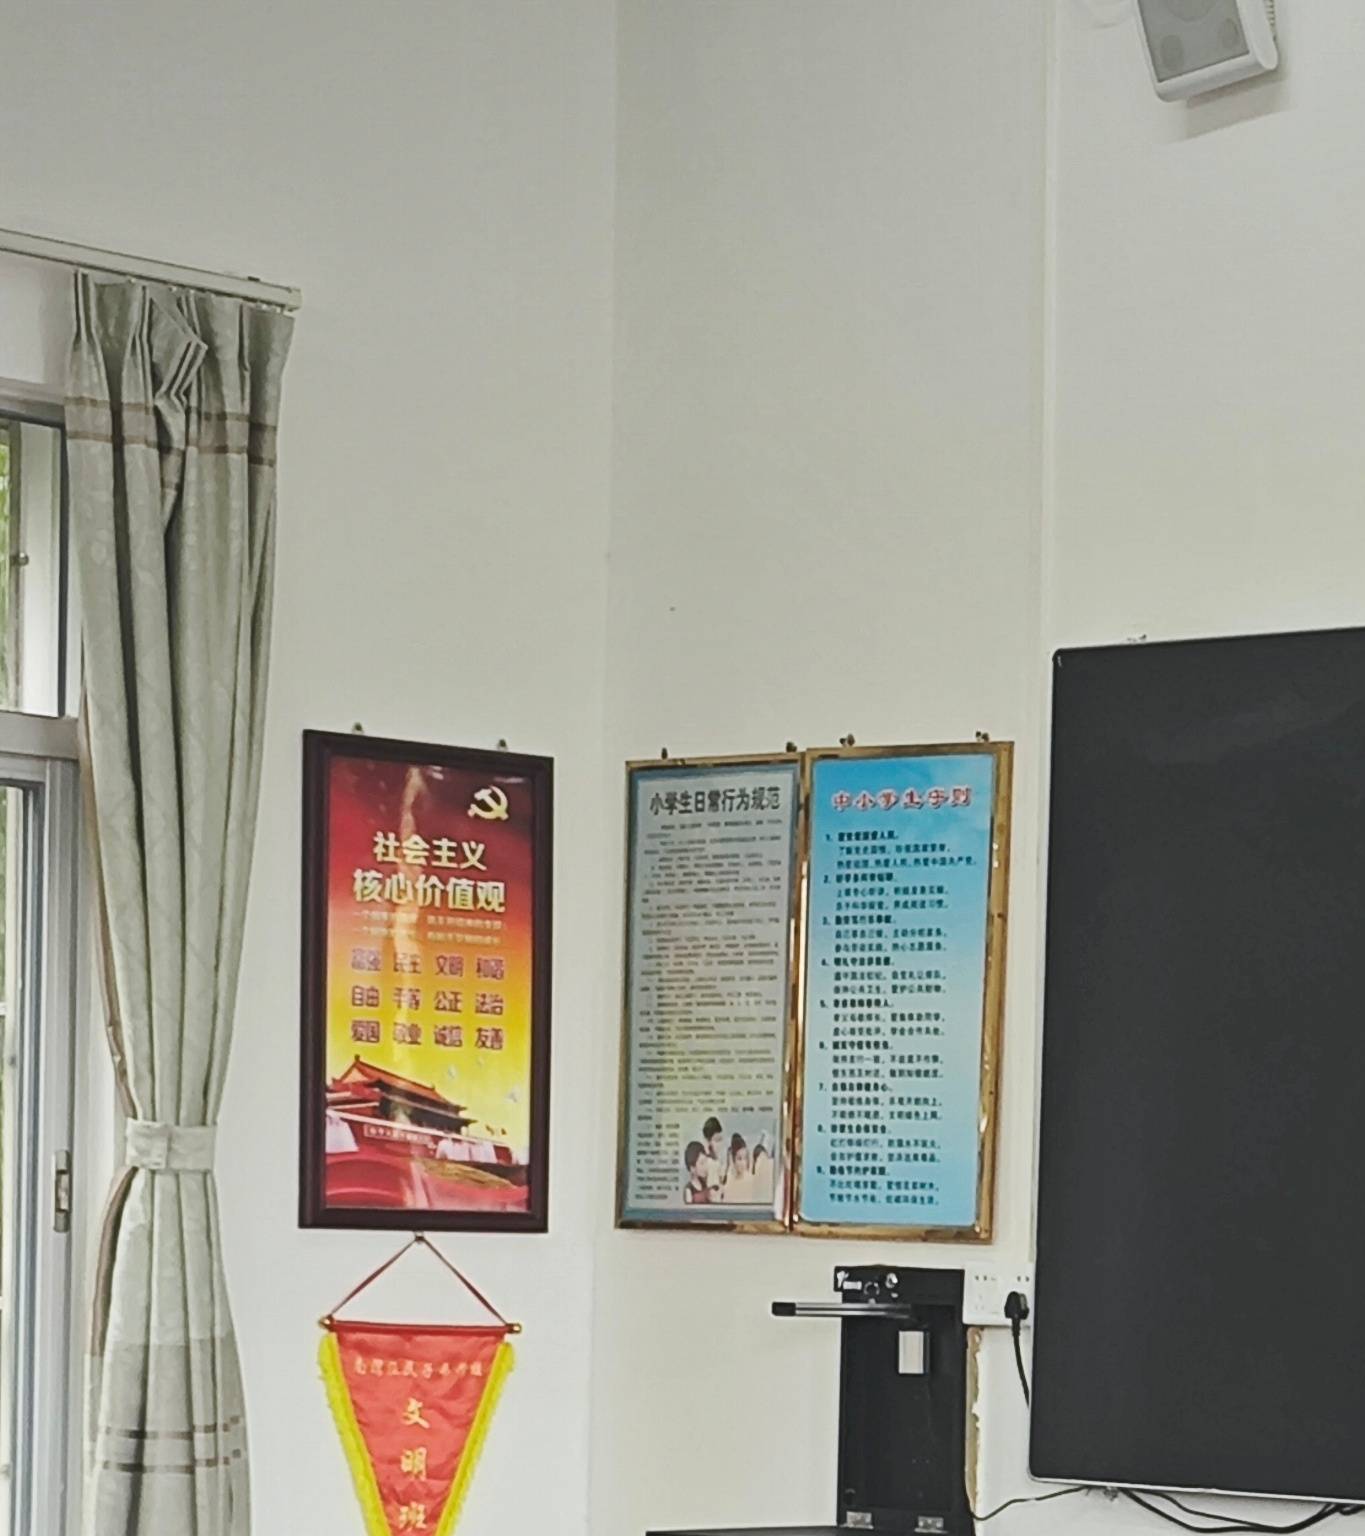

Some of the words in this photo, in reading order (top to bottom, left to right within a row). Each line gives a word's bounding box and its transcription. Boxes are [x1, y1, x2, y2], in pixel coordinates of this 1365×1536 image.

[650, 786, 781, 816] 小学生日常行为规范
[373, 831, 487, 870] 社会主义
[353, 869, 505, 912] 核心价值观
[436, 955, 464, 977] 文明
[352, 985, 380, 1007] 自由
[434, 991, 463, 1013] 公正
[475, 993, 504, 1015] 法治
[352, 1020, 380, 1043] 爱国
[434, 1024, 463, 1047] 诚信
[475, 1027, 504, 1050] 友善
